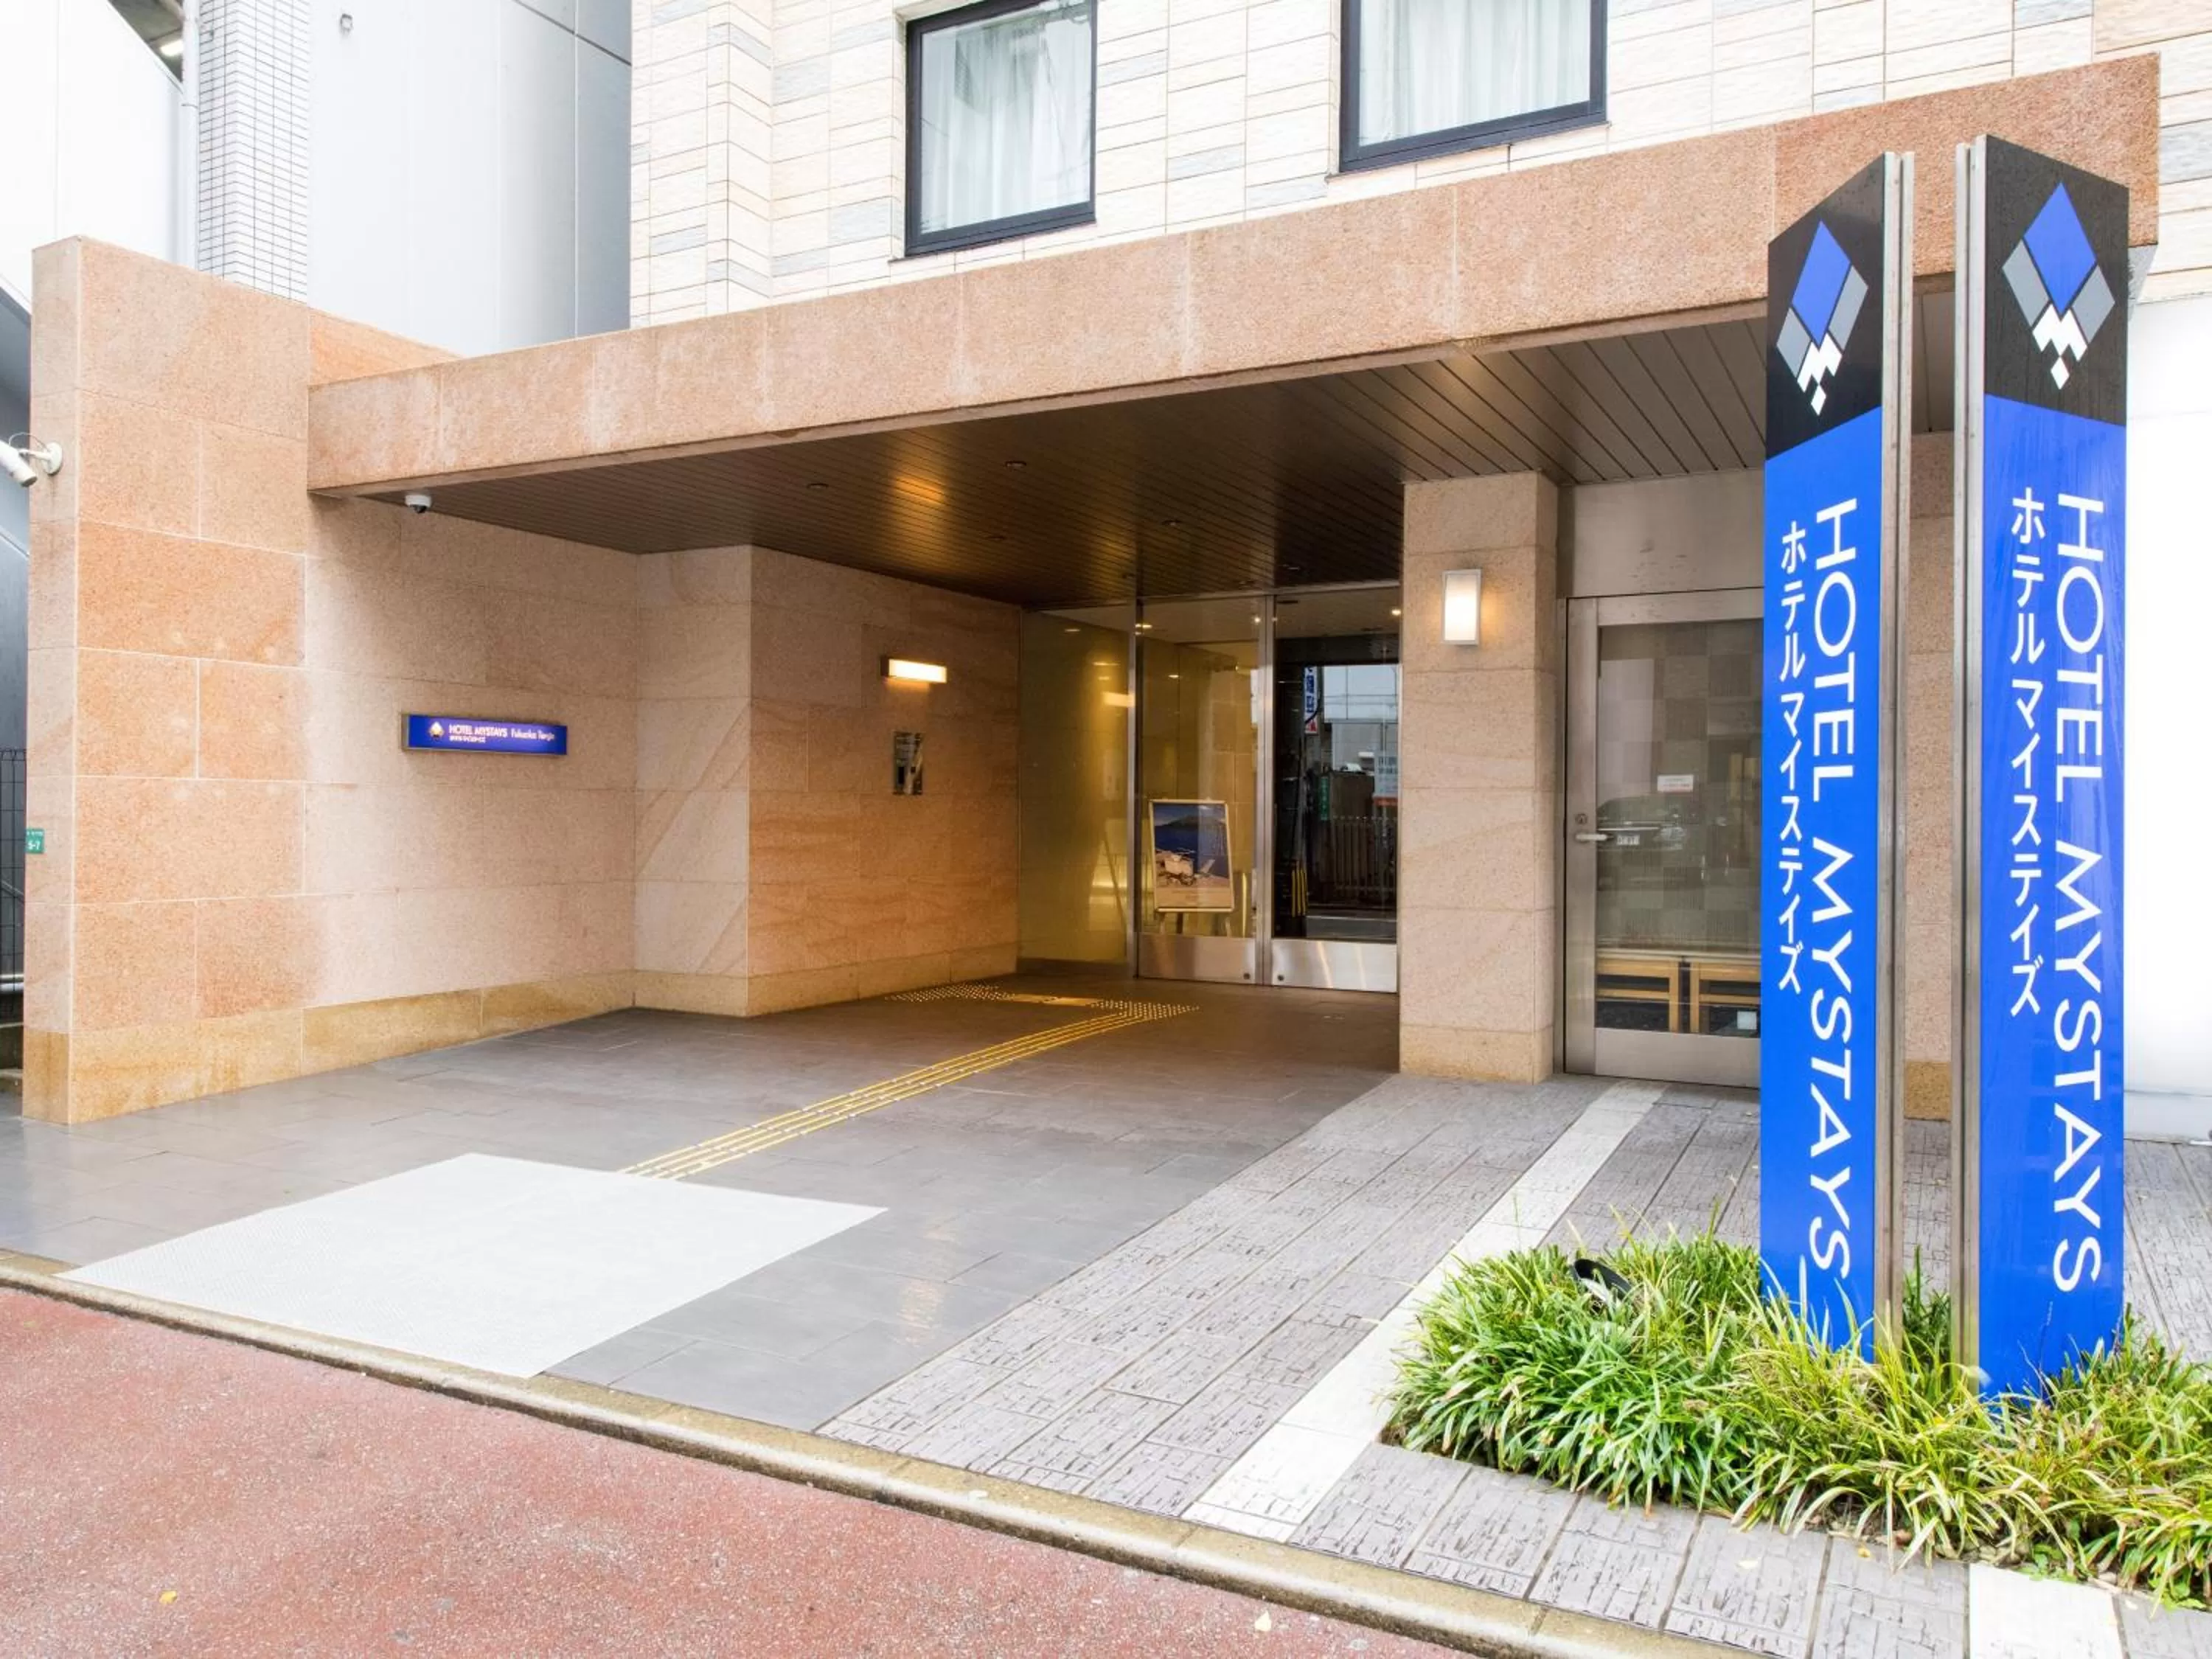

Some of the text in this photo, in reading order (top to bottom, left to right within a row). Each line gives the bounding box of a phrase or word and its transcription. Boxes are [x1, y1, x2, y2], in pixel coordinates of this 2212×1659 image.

[448, 724, 473, 735] HOTEL
[474, 726, 507, 737] MYSTAYS
[1809, 498, 1857, 1279] HOTEL MYSTAYS
[2053, 493, 2104, 1292] HOTEL MYSTAYS
